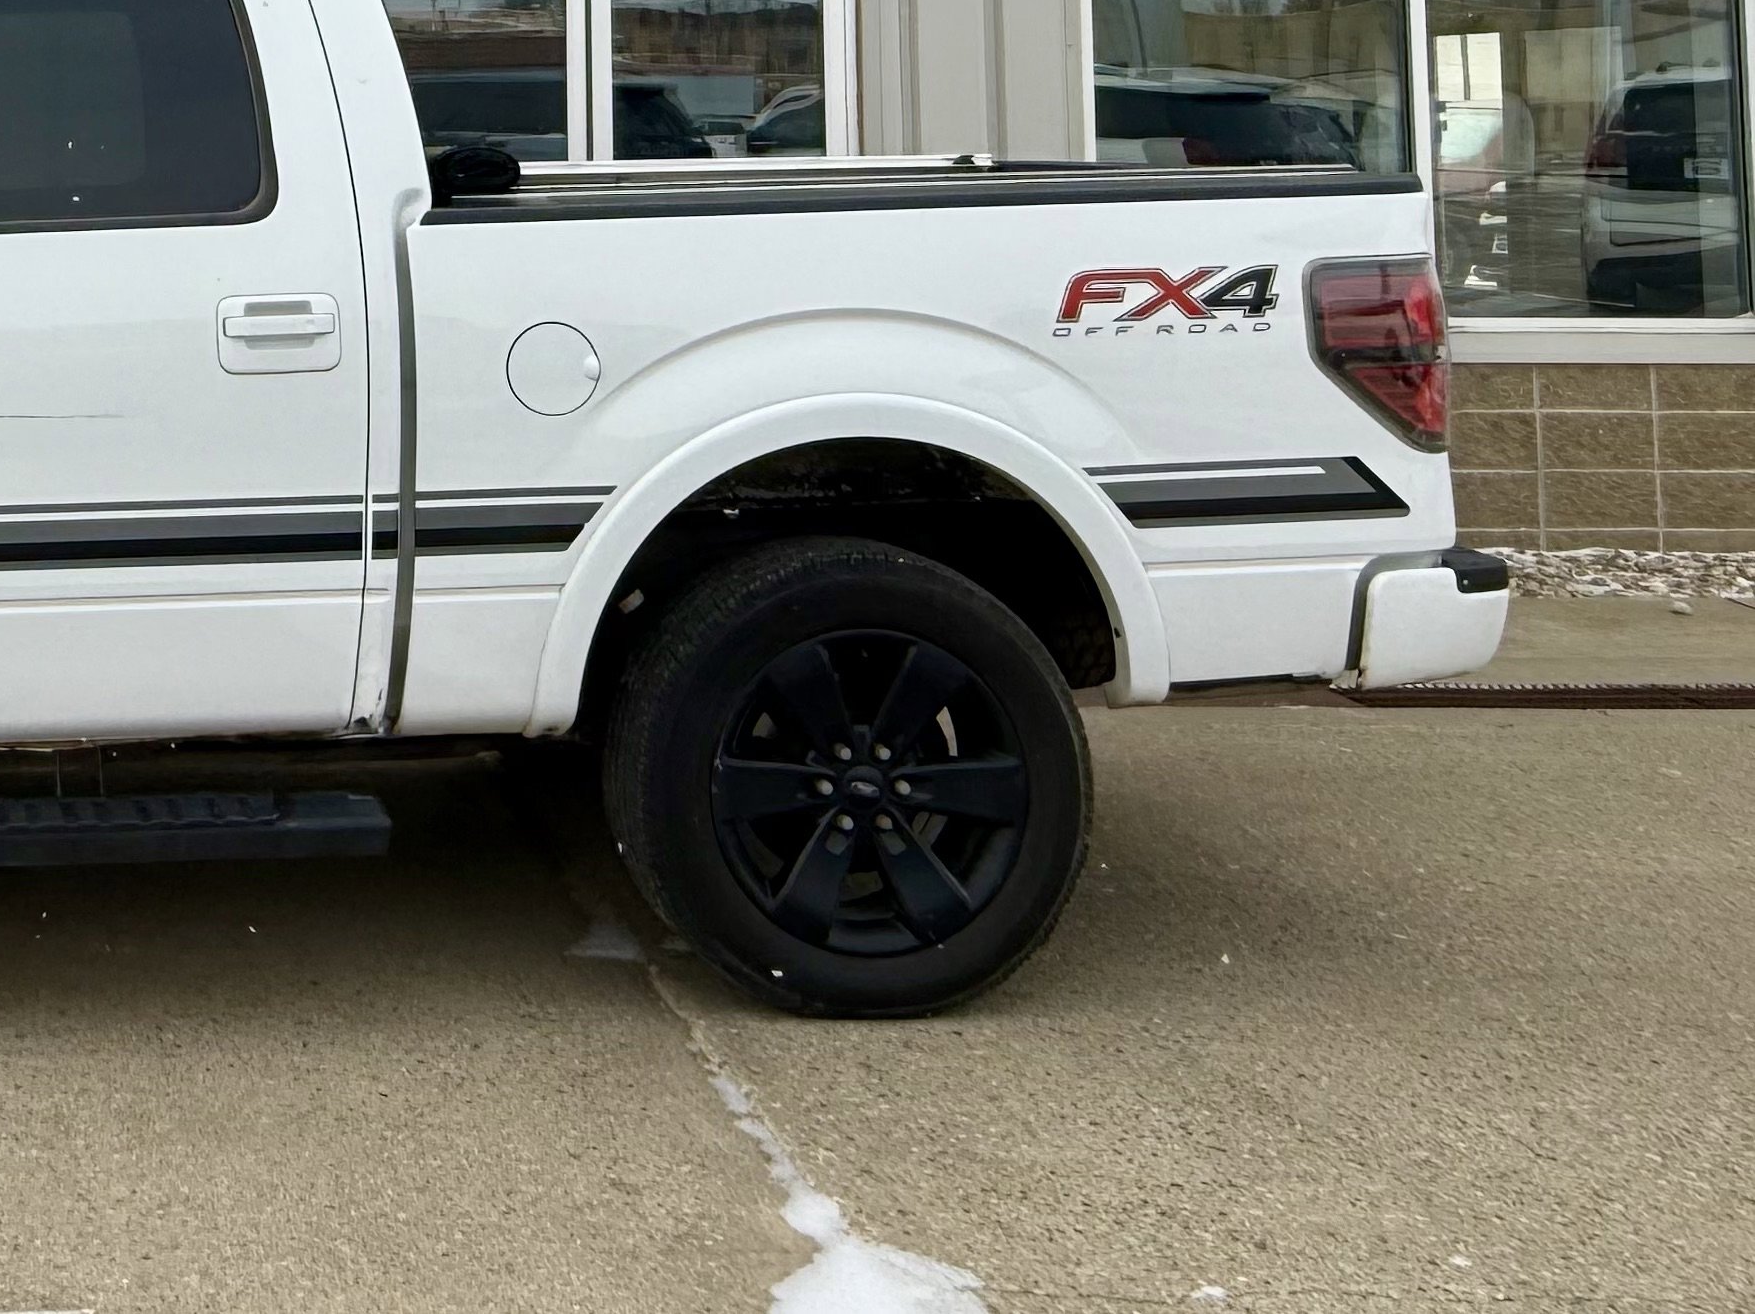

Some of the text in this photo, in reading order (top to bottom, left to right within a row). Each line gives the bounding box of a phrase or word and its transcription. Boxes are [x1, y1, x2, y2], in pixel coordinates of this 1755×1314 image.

[1056, 264, 1279, 323] FX4
[1052, 322, 1271, 337] OFF ROAD
